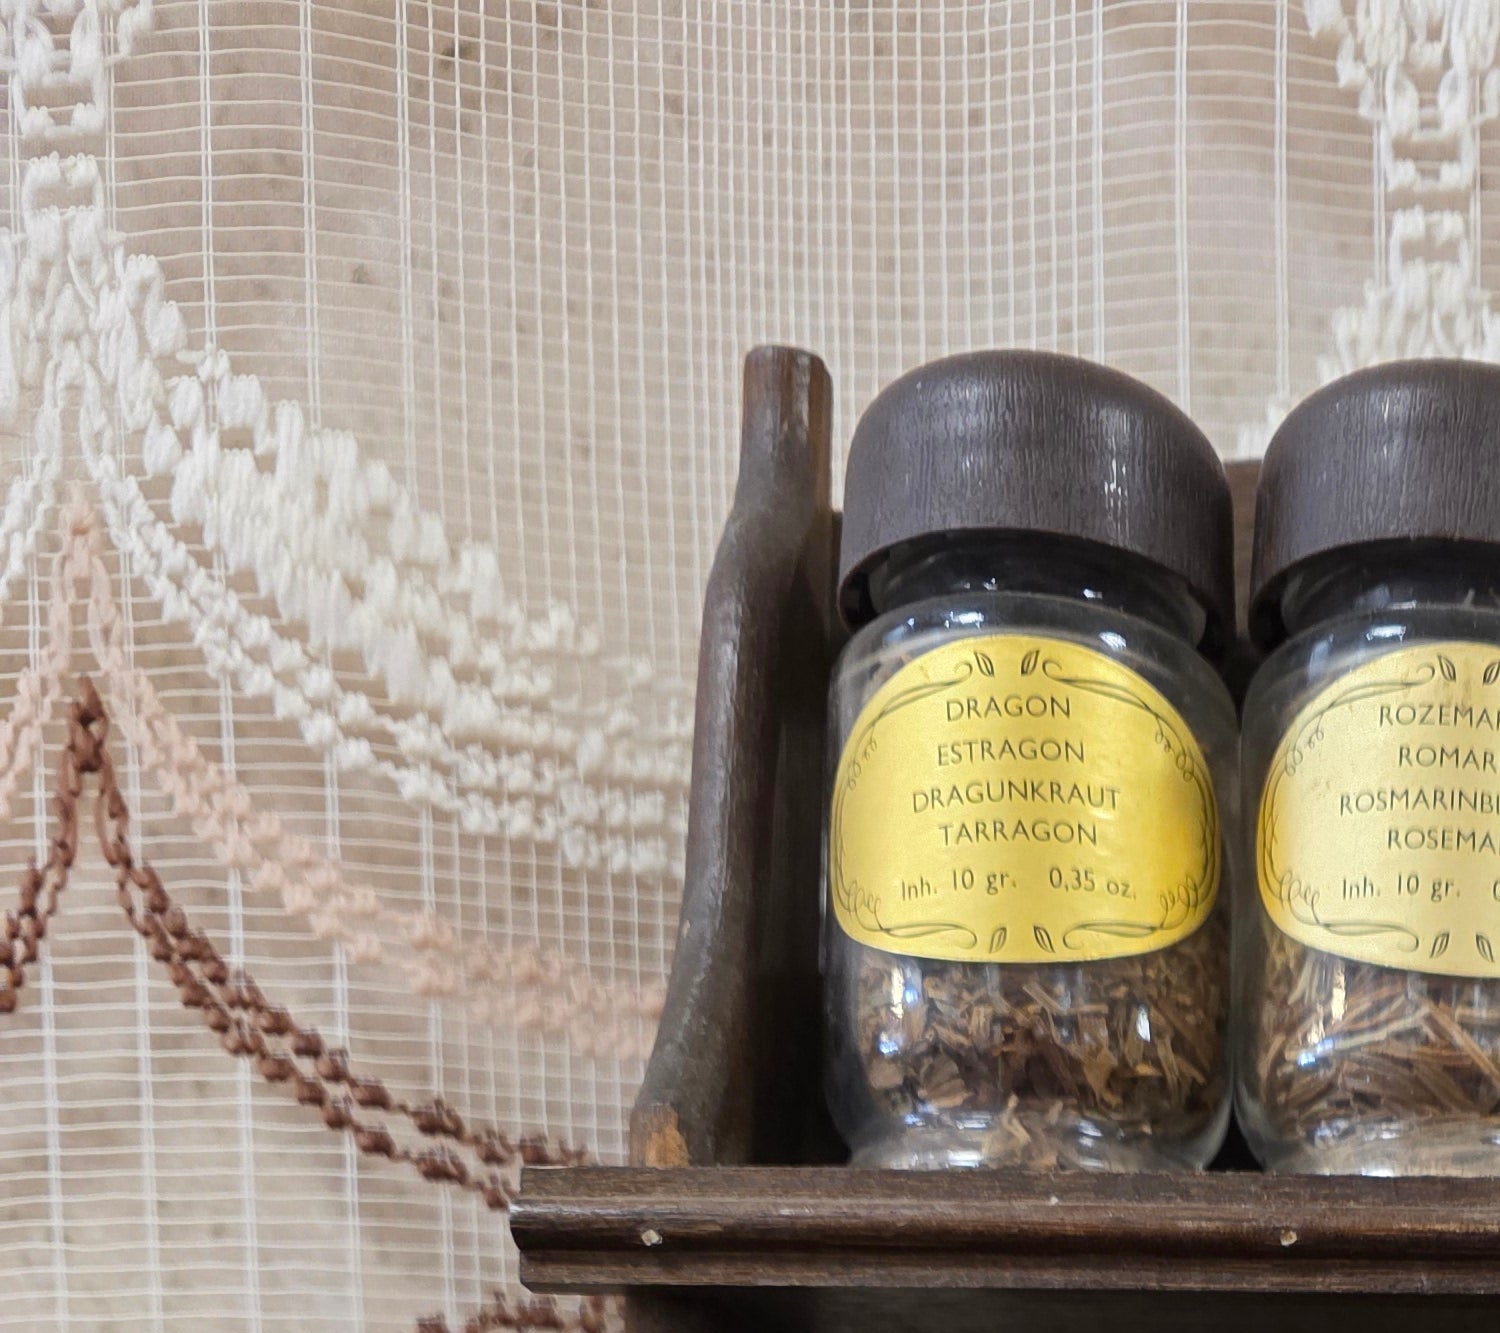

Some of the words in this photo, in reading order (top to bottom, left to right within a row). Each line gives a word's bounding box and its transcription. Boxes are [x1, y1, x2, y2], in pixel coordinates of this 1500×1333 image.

[946, 696, 1071, 722] DRAGON
[938, 739, 1085, 767] ESTRAGON
[912, 780, 1120, 813] DRAGUNKRAUT
[939, 820, 1098, 847] TARRAGON
[901, 879, 938, 901] Inh.
[952, 869, 975, 891] 10
[986, 871, 1017, 896] gr.
[1049, 868, 1095, 893] 0,35
[1107, 879, 1137, 900] oz.
[1342, 877, 1380, 900] Inh.
[1397, 872, 1420, 896] 10
[1431, 879, 1460, 902] gr.
